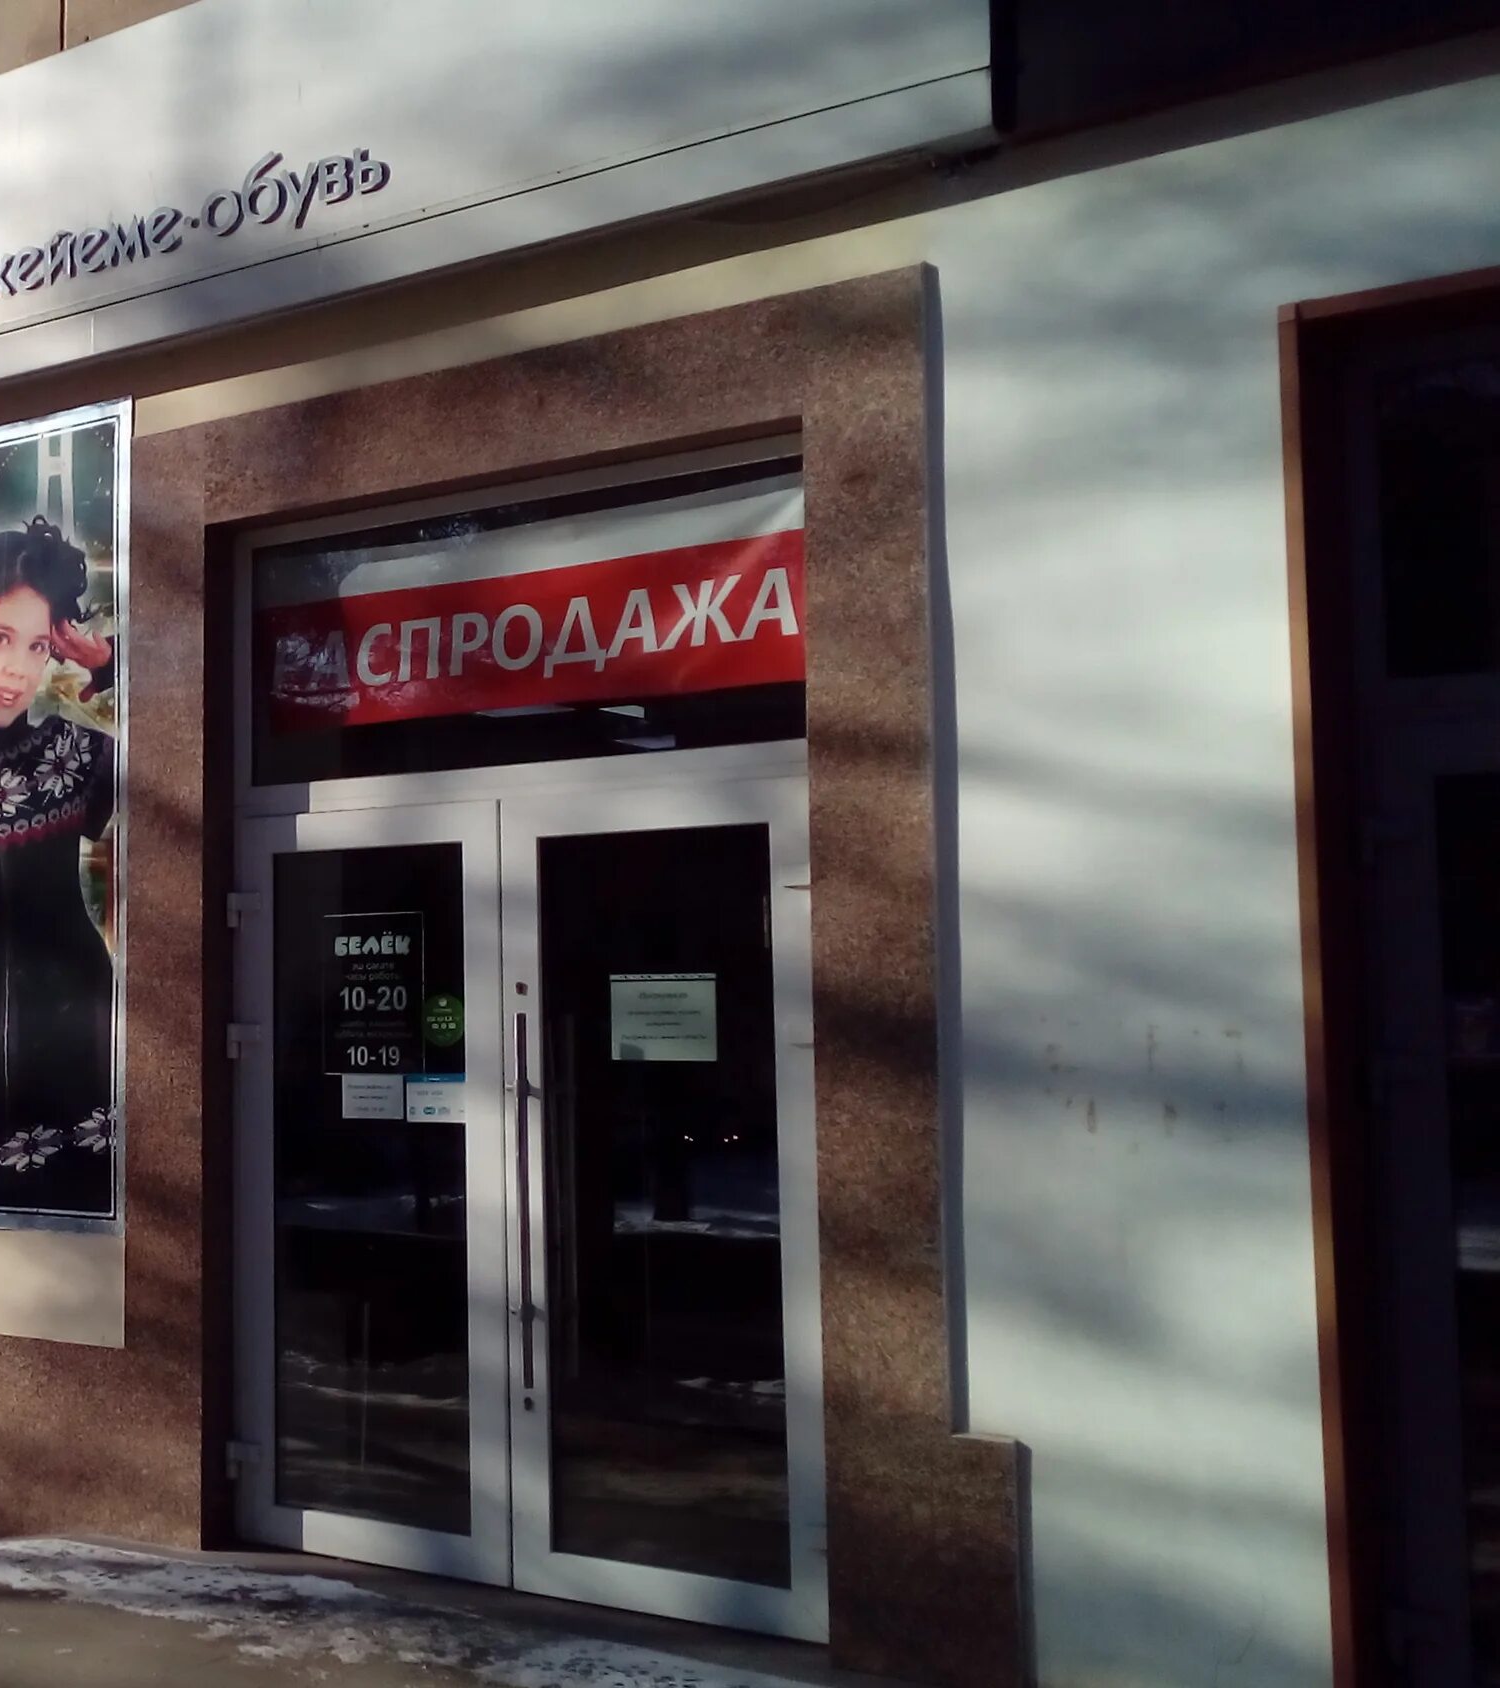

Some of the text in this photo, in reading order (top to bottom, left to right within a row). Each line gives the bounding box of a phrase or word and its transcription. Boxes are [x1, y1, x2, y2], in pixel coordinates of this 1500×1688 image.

[272, 566, 800, 691] РАСПРОДАЖА
[334, 930, 411, 956] БЕЛЁК
[339, 986, 408, 1011] 10-20
[346, 1046, 400, 1066] 10-19
